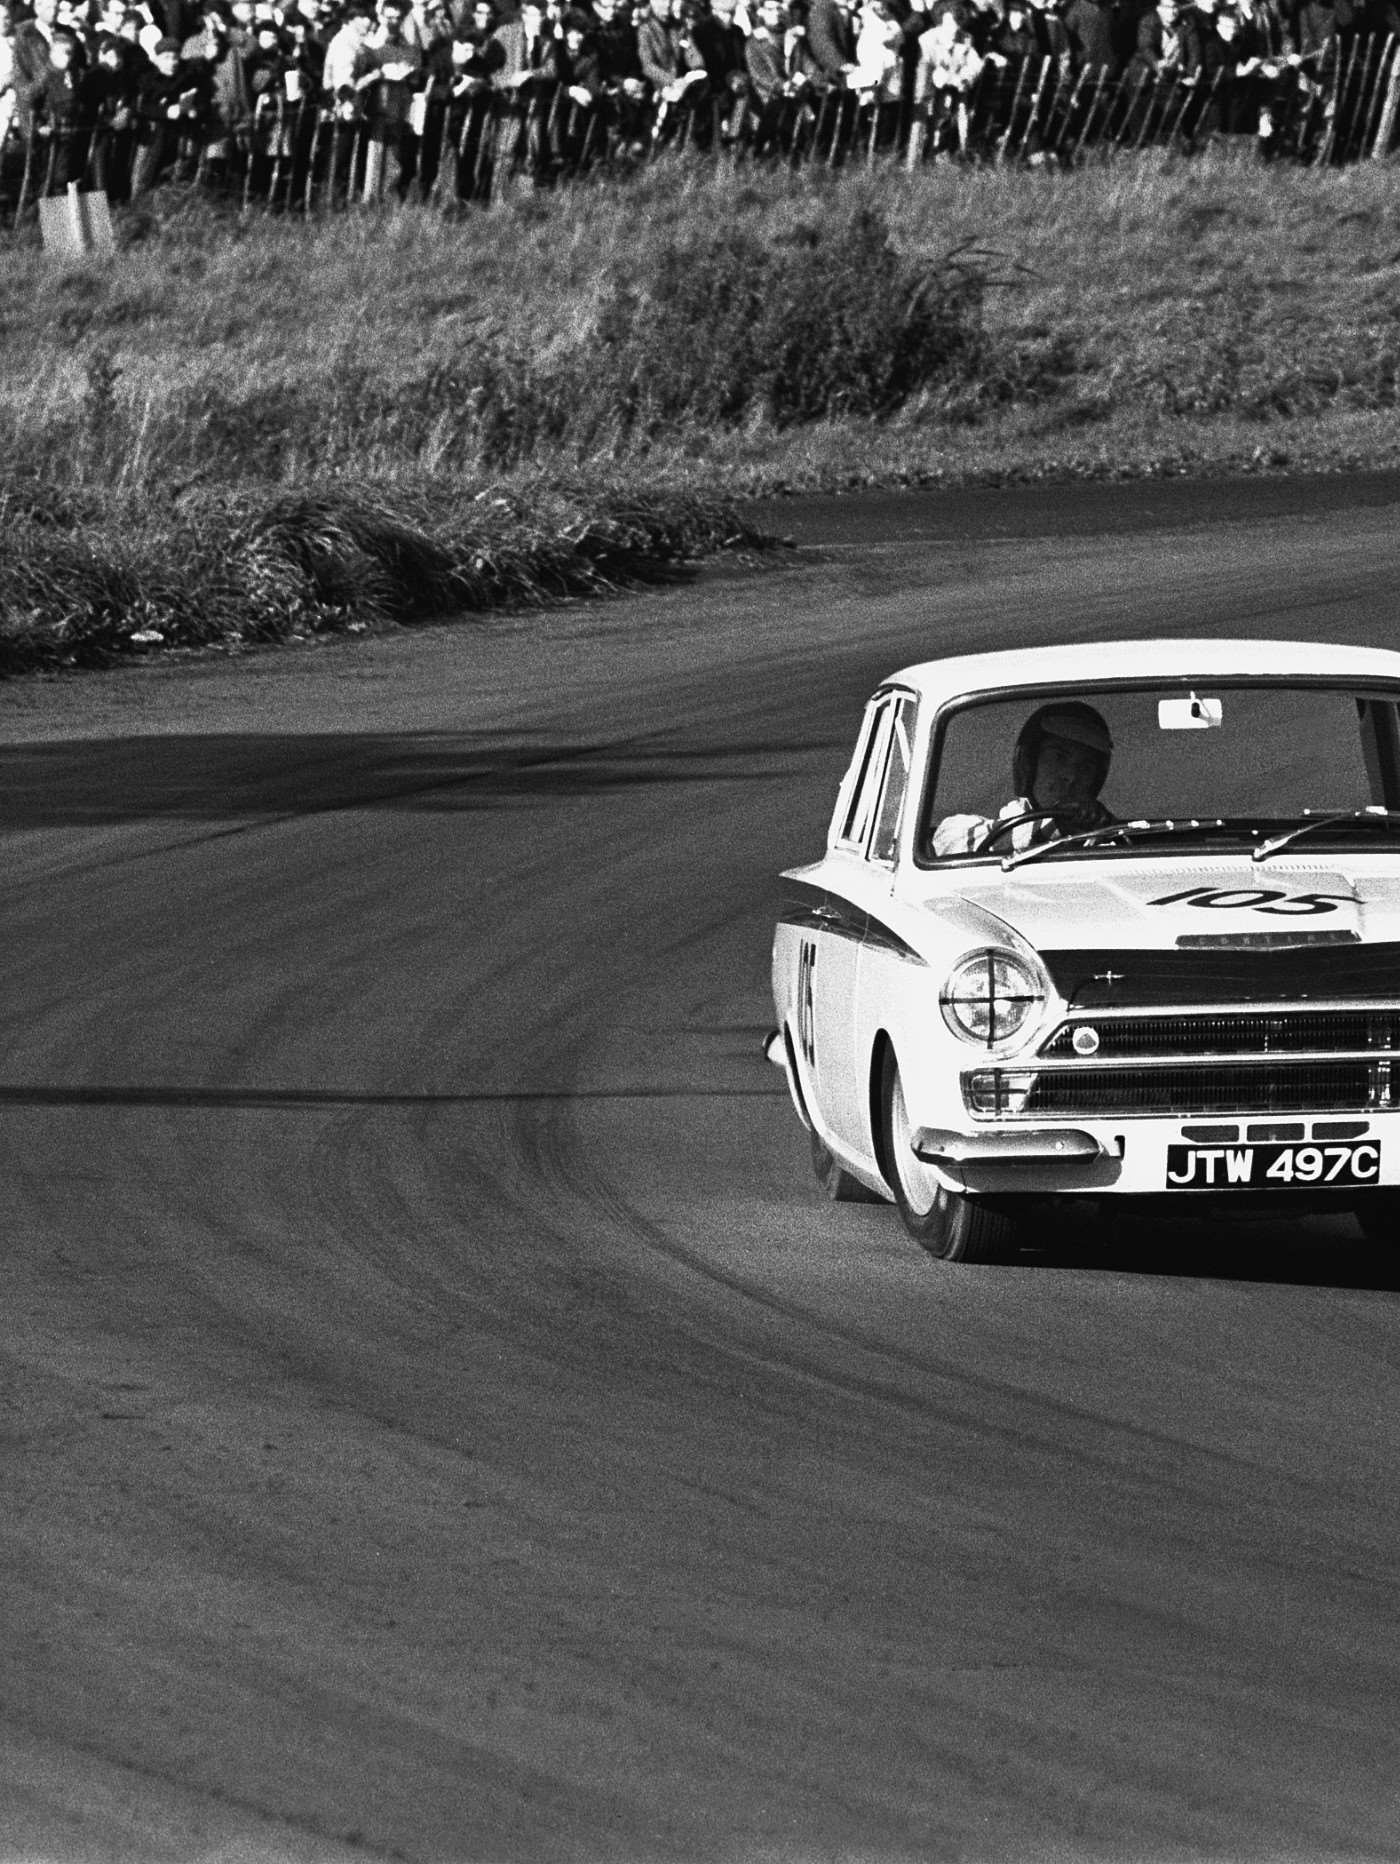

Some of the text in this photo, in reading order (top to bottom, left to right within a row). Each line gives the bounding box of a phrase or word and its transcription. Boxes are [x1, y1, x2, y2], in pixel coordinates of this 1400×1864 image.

[1146, 887, 1369, 915] 105
[1167, 1145, 1379, 1184] JTW 497C
